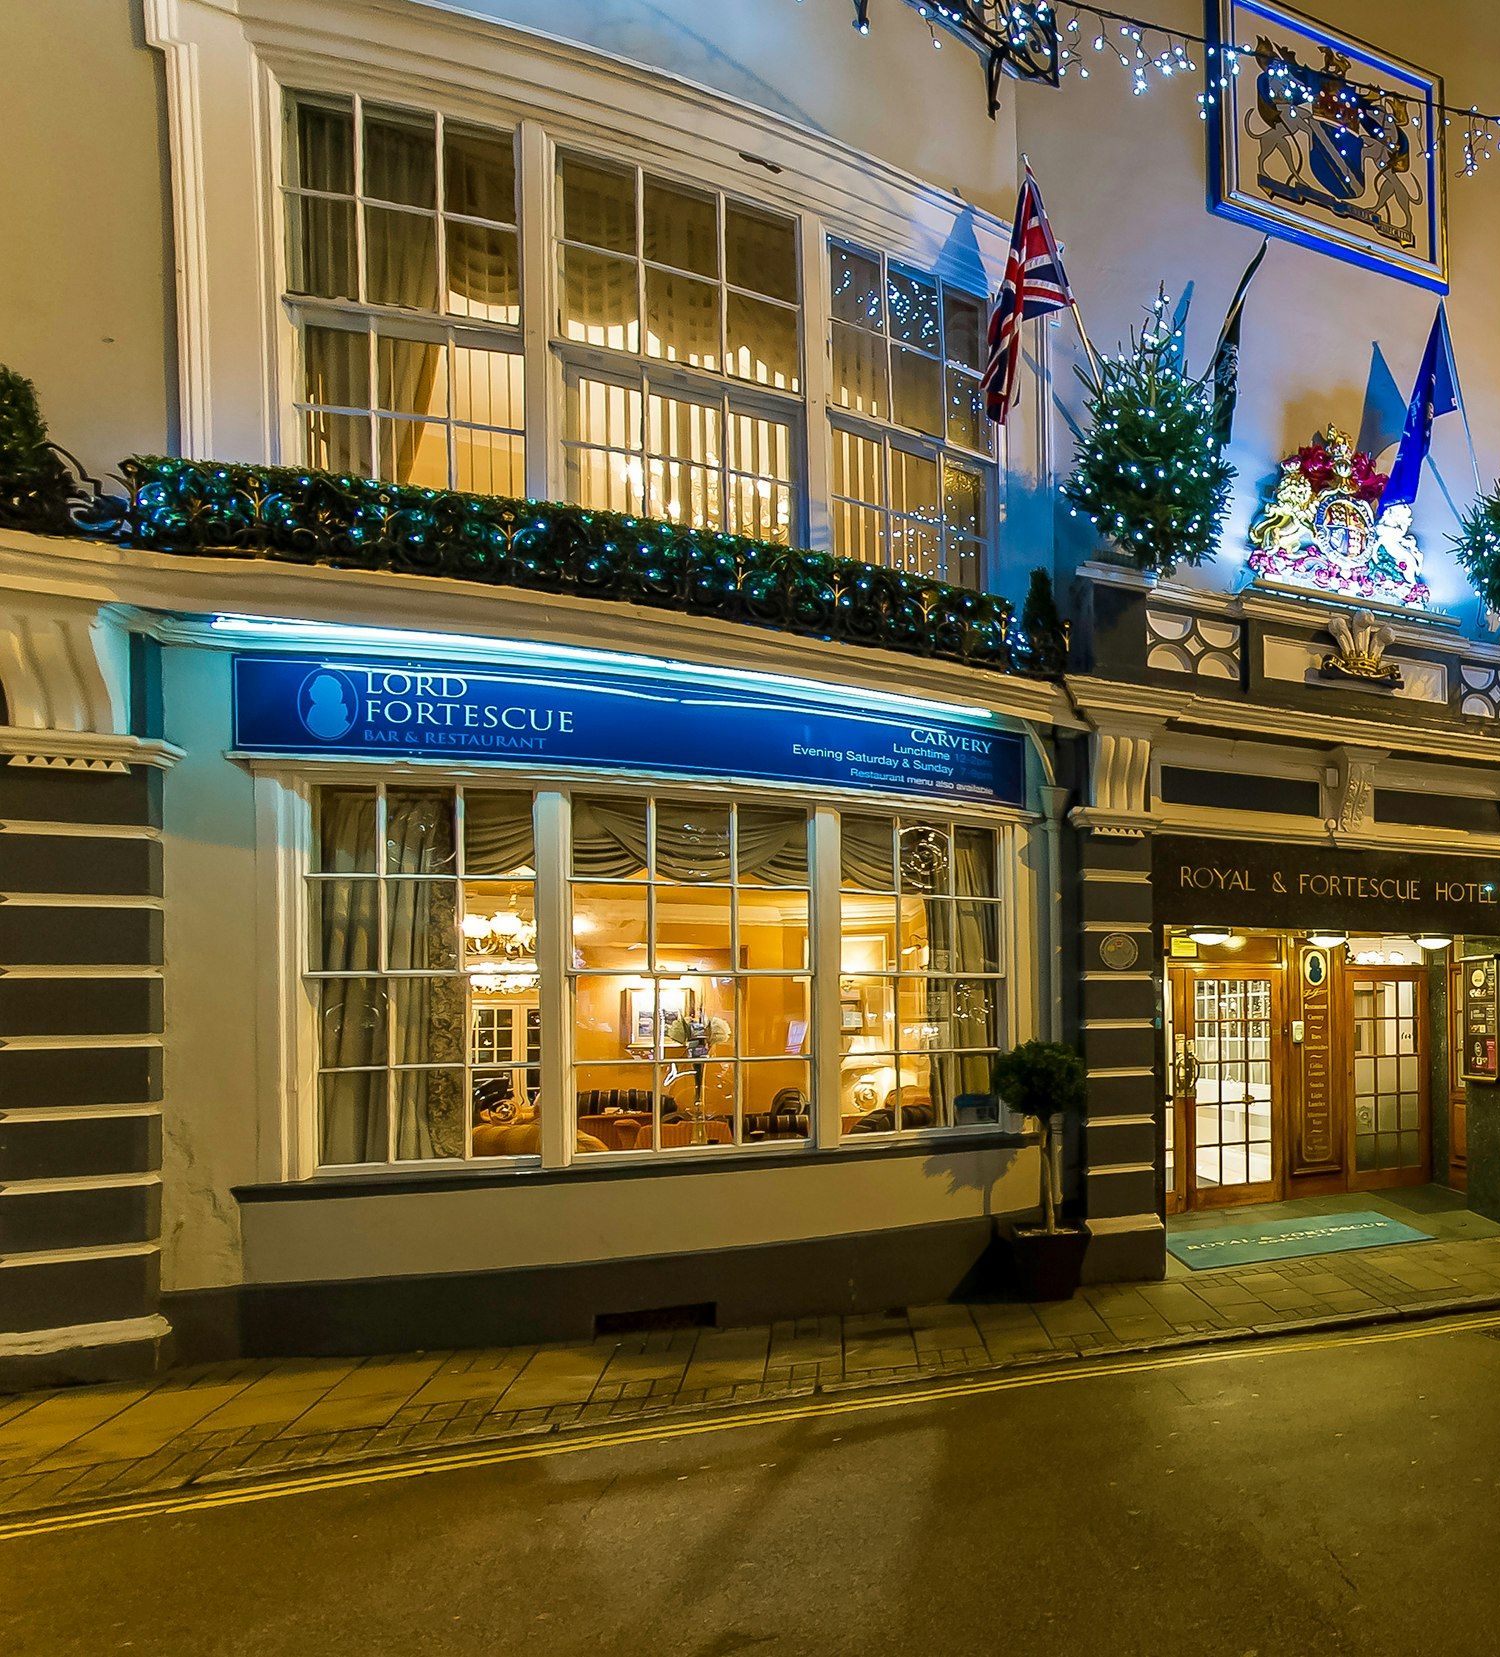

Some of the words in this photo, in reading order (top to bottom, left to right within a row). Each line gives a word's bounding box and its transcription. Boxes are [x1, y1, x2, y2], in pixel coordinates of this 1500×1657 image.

[366, 671, 468, 698] LORD
[366, 700, 574, 733] FORTESCUE
[364, 730, 400, 742] BAR
[405, 731, 419, 743] &
[425, 731, 547, 750] RESTAURANT
[893, 743, 950, 761] Lunchtime
[911, 729, 992, 754] CARVERY
[792, 744, 843, 761] Evening
[846, 750, 899, 768] Saturday
[902, 758, 911, 768] &
[913, 760, 954, 777] Sunday
[850, 768, 905, 784] Restaurant
[907, 776, 934, 787] menu
[935, 779, 955, 790] also
[956, 782, 994, 795] available
[1180, 866, 1256, 891] ROYAL
[1272, 871, 1287, 893] &
[1300, 873, 1421, 900] FORTESCUE
[1435, 882, 1498, 904] HOTEL
